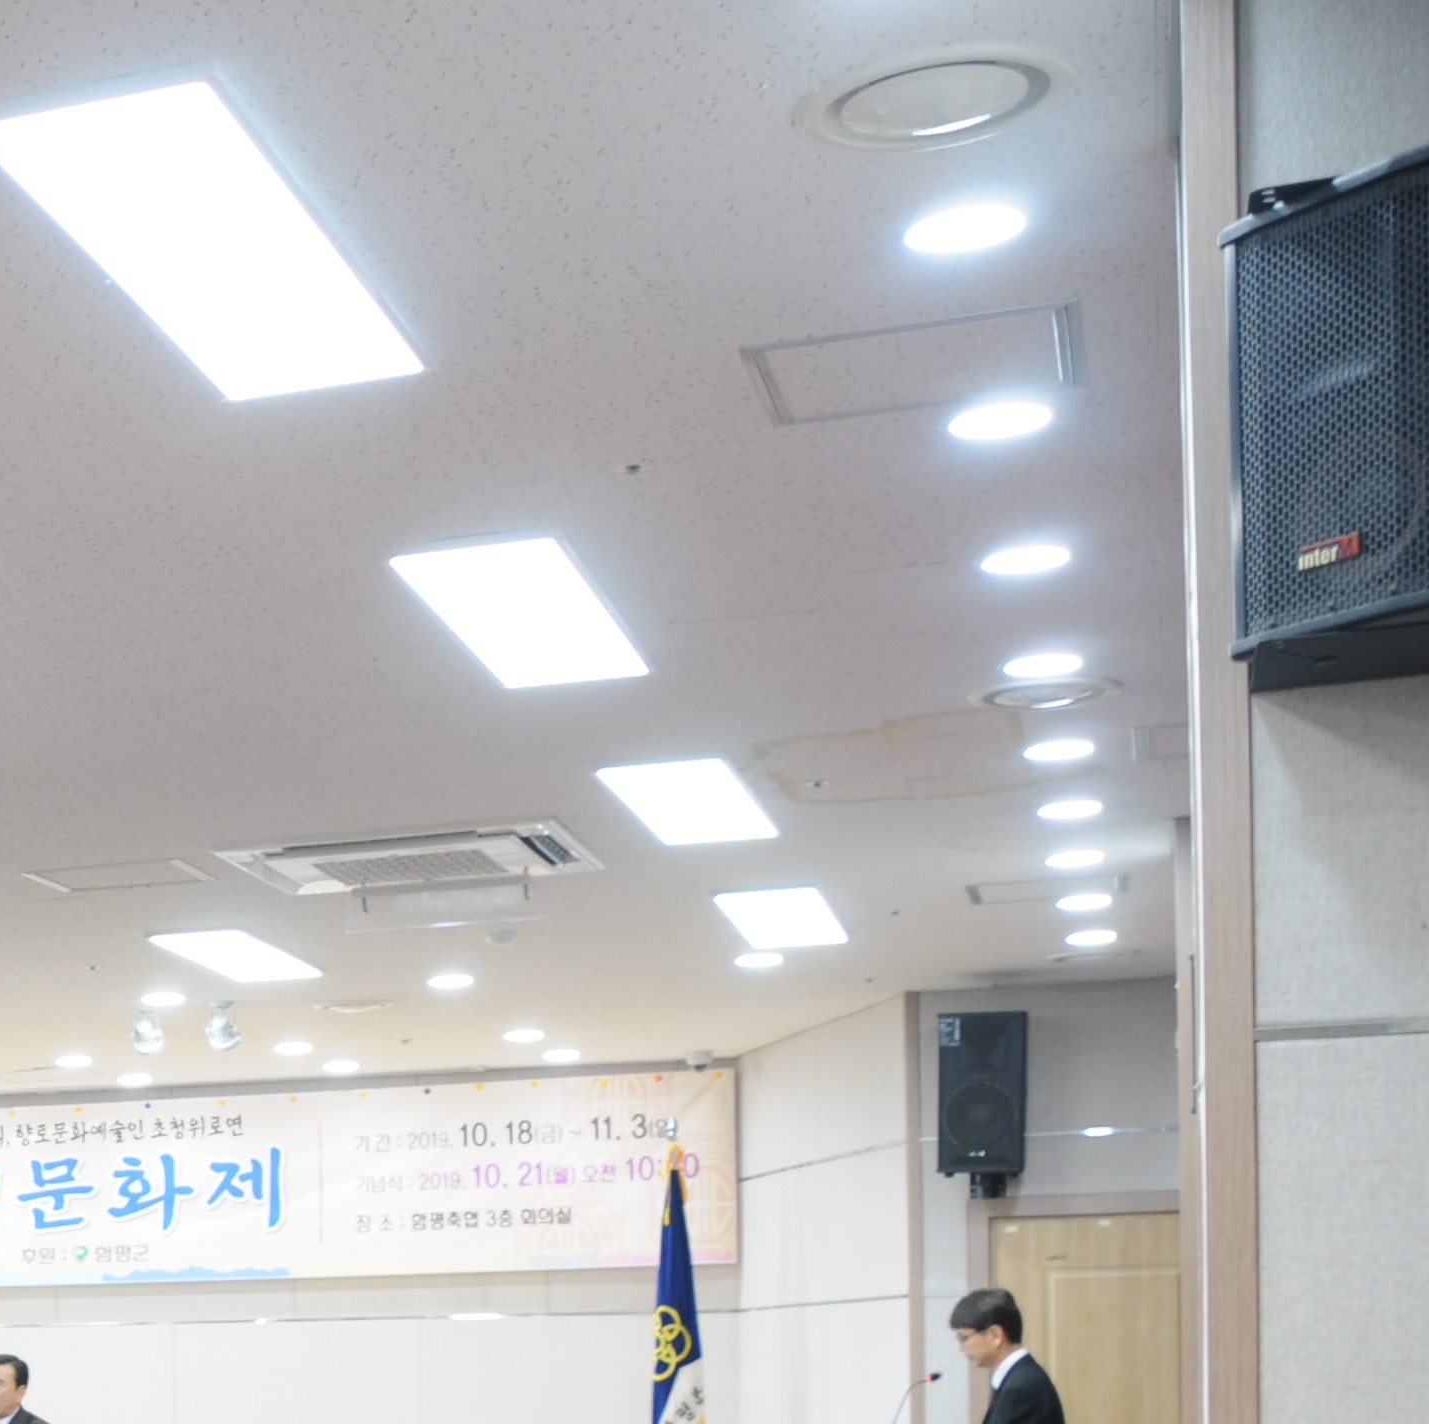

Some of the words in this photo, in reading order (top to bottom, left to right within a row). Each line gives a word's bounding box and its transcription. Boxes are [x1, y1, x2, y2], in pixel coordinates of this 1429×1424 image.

[15, 1121, 143, 1146] 향토문화예술인
[151, 1115, 244, 1139] 초청위로연
[355, 1174, 403, 1193] 기념식
[582, 1165, 616, 1182] 오전
[626, 1153, 700, 1181] 10:0
[486, 1210, 513, 1227] 3층
[521, 1207, 572, 1226] 회의실
[22, 1247, 56, 1265] 후원
[95, 1244, 149, 1263] 함평군
